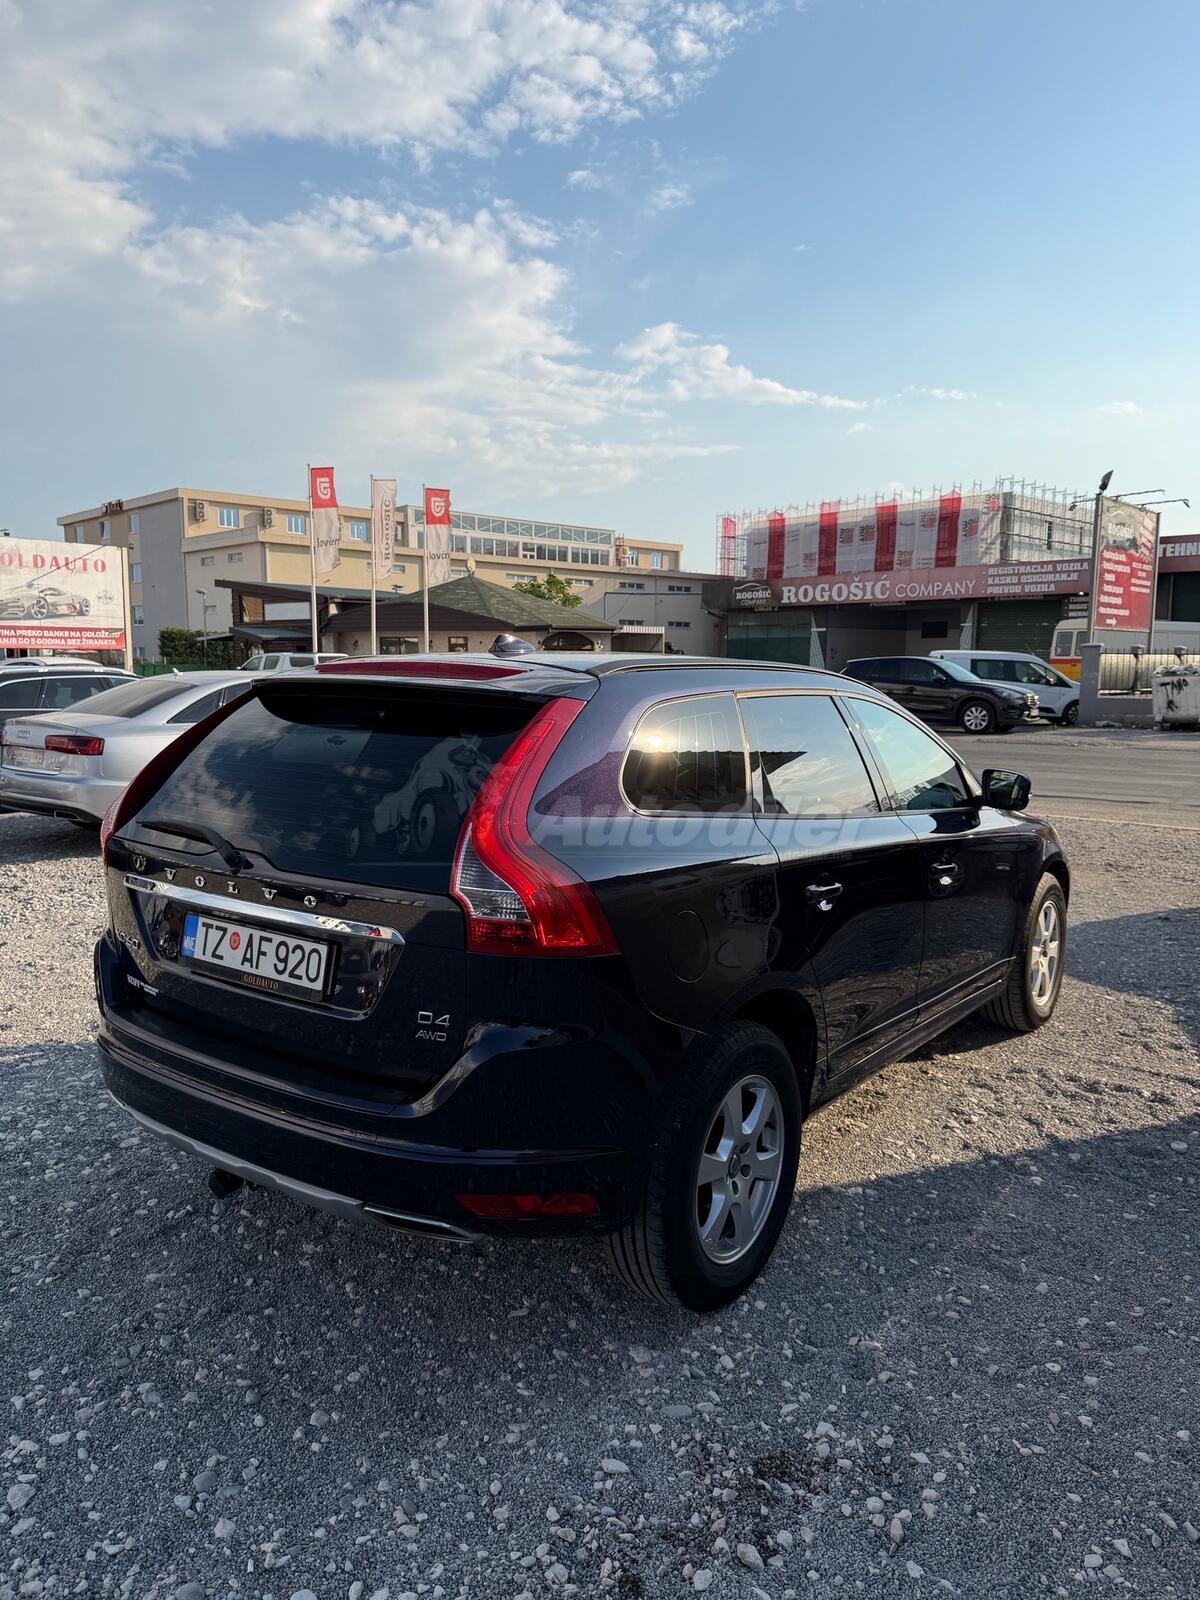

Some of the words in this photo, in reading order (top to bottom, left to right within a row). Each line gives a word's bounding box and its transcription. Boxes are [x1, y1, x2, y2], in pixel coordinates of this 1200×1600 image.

[988, 563, 1053, 575] REGISTRACIJA
[1055, 562, 1089, 571] VOZILA
[987, 575, 1018, 585] KASKO
[1020, 572, 1079, 583] OSIGURANJE
[781, 575, 890, 603] ROGOŠIĆ
[895, 580, 976, 598] COMPANY
[1024, 583, 1056, 593] VOZILA
[16, 629, 43, 637] PREKO
[43, 630, 70, 638] BANKE
[81, 637, 117, 646] ŽIRANATA
[164, 867, 318, 909] VOLVO
[201, 921, 228, 961] TZ
[240, 932, 322, 983] AF920
[243, 974, 279, 991] GOLDAUTO
[418, 1010, 451, 1028] D4
[415, 1029, 447, 1042] AWD
